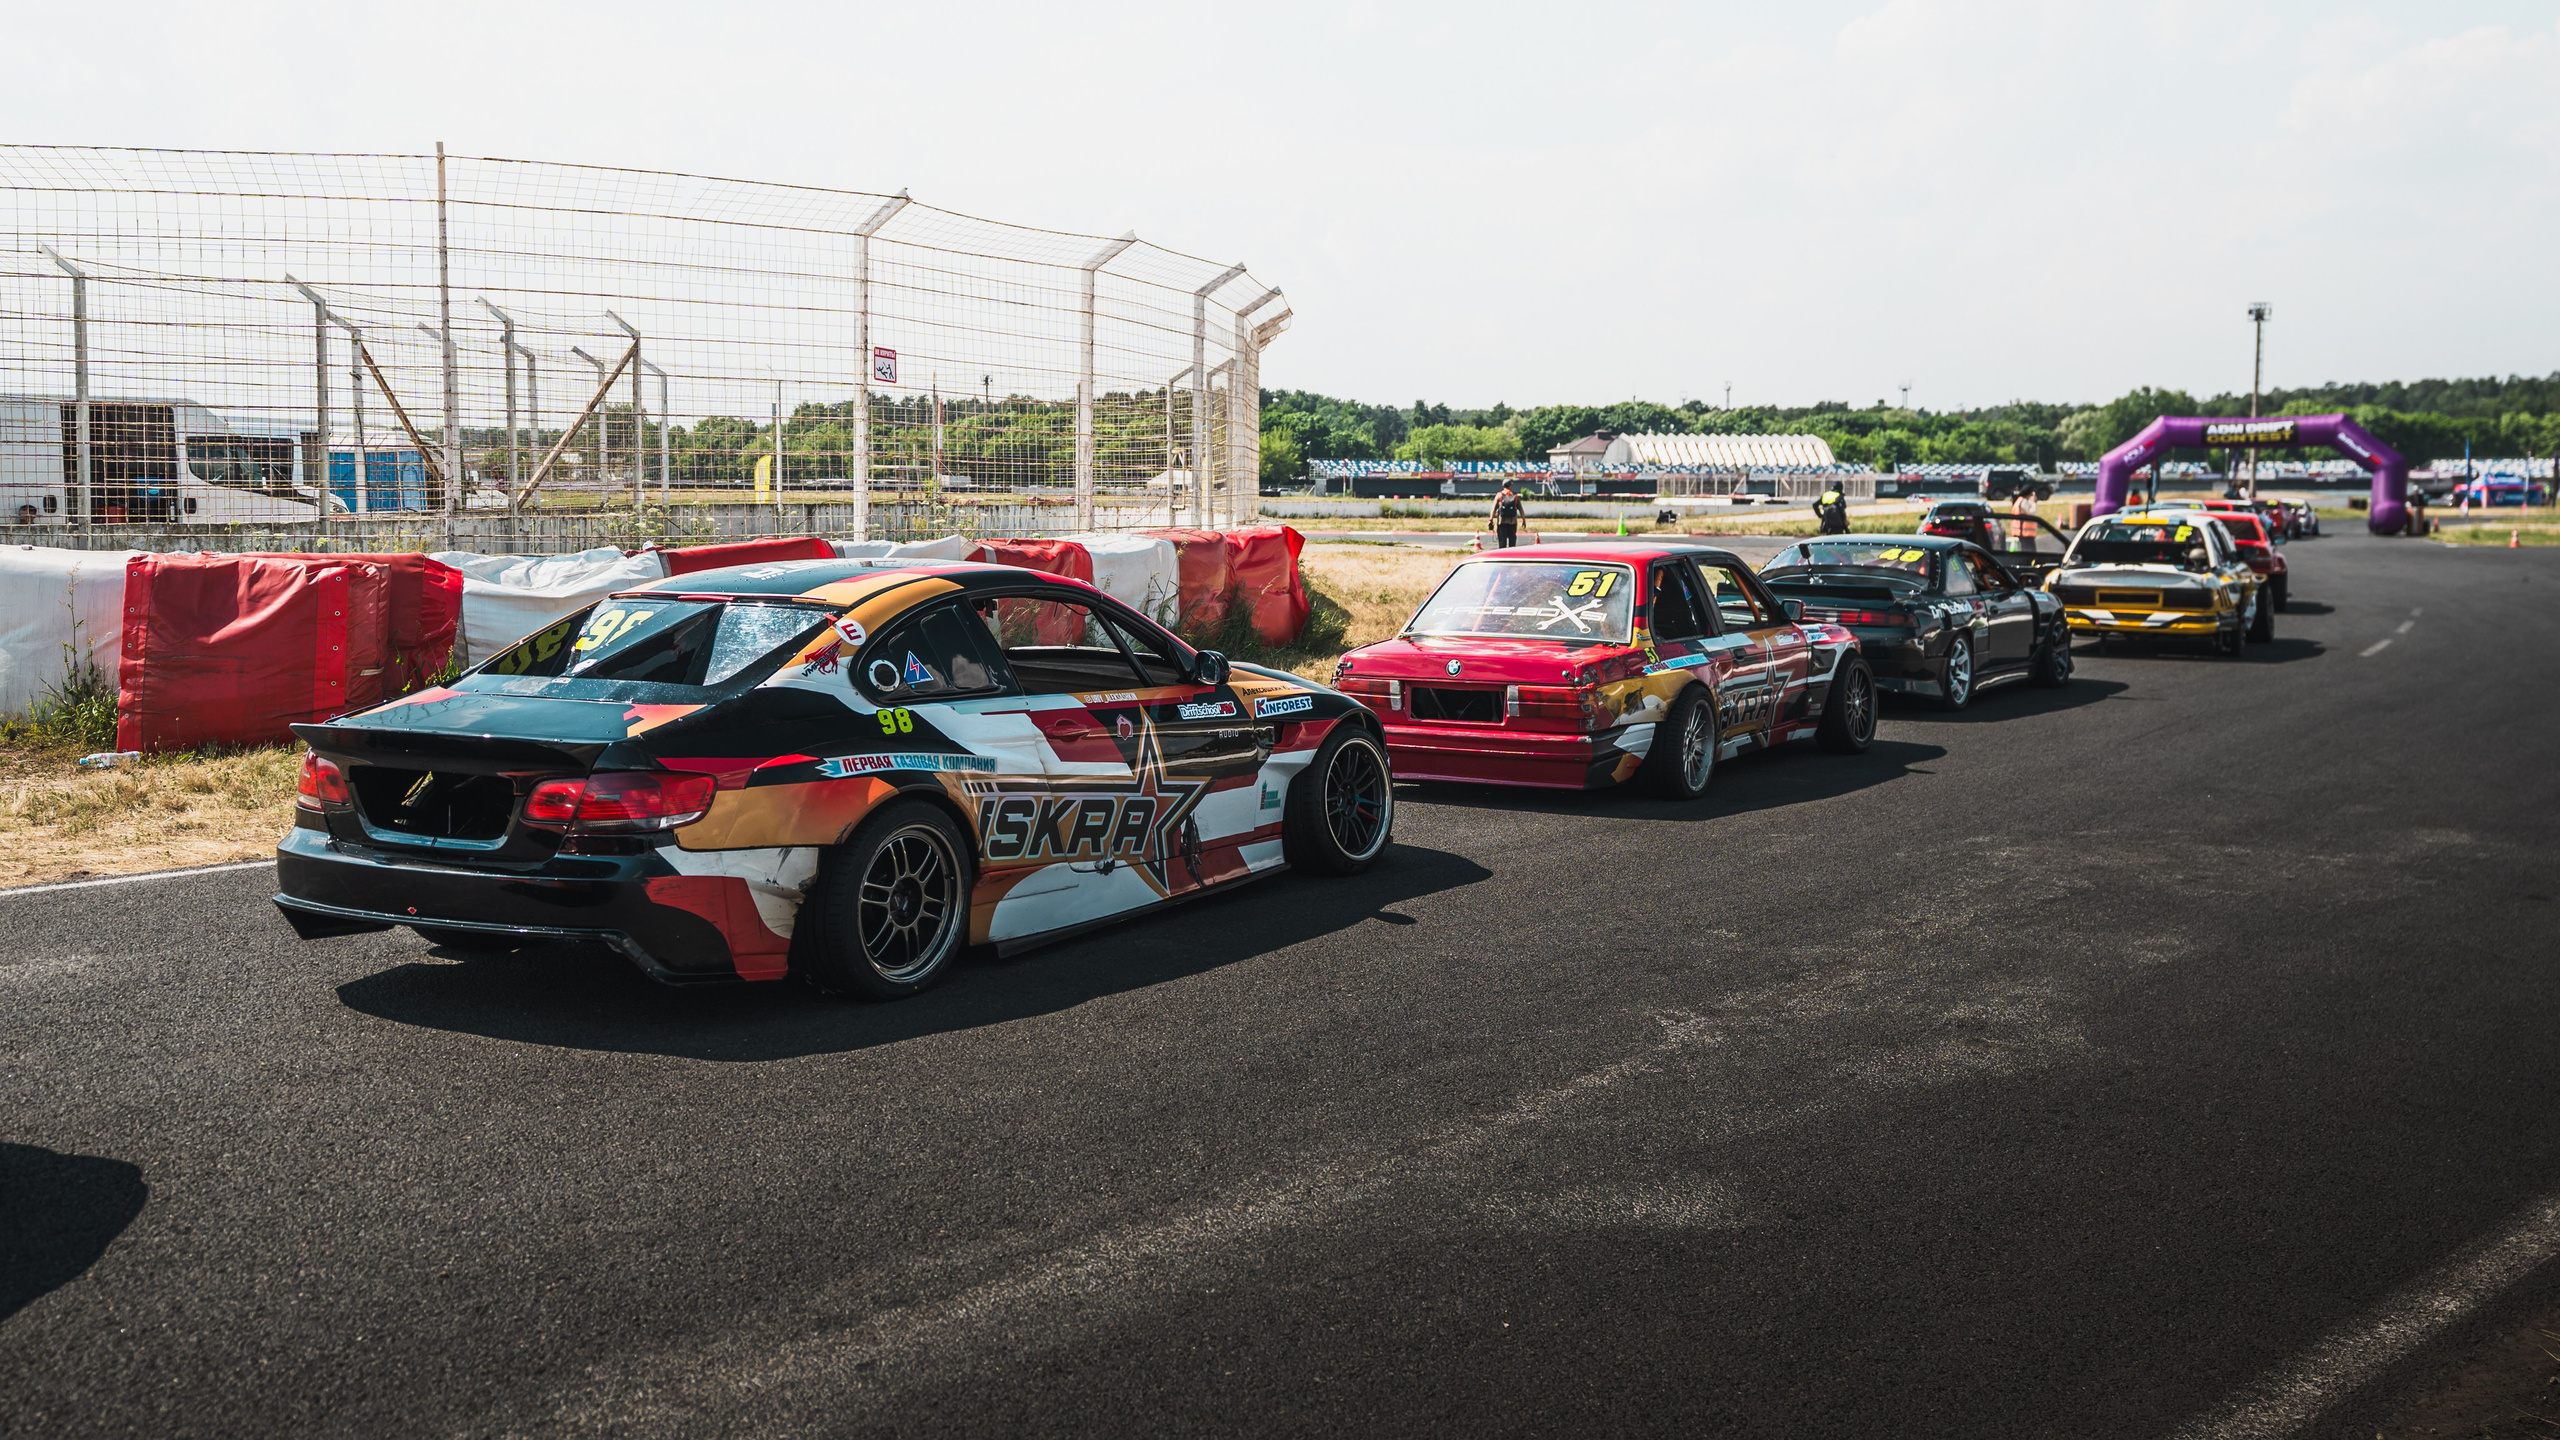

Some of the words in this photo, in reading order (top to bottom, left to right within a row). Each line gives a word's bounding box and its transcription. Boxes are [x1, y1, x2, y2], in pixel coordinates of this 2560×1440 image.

[2207, 423, 2244, 434] ADM
[2245, 421, 2294, 433] DRIFT
[2207, 430, 2294, 443] CONTEST
[1567, 571, 1618, 598] 51
[801, 646, 839, 677] VMPAUTO
[1256, 698, 1312, 716] KINFOREST
[877, 708, 913, 735] 98
[1218, 729, 1239, 739] AUDIO
[842, 755, 894, 773] ПЕРВАЯ
[894, 755, 940, 770] ГАЗОВАЯ
[942, 755, 996, 773] КОМПАНИЯ
[978, 796, 1157, 861] ISKRA
